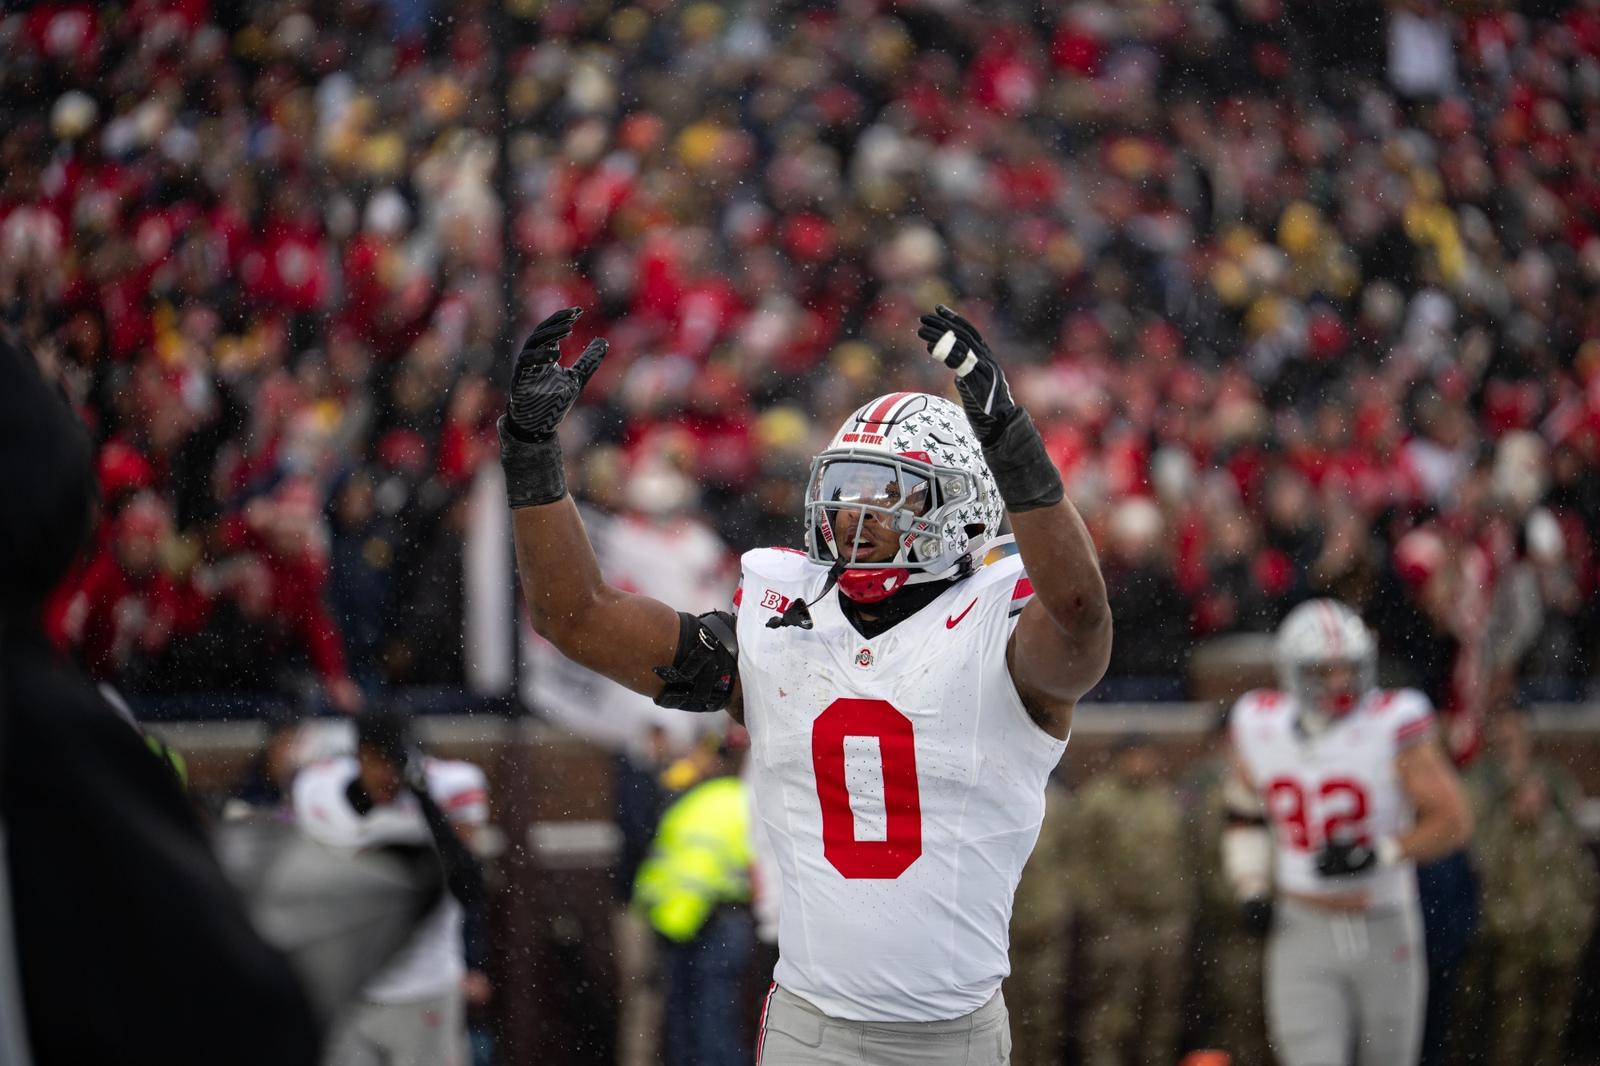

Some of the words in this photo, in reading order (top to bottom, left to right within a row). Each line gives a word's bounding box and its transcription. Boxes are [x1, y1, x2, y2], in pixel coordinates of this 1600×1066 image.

[842, 433, 860, 443] OHIO
[860, 433, 884, 445] STATE
[821, 524, 834, 544] STATE
[811, 697, 923, 880] 0
[1266, 774, 1369, 853] 92
